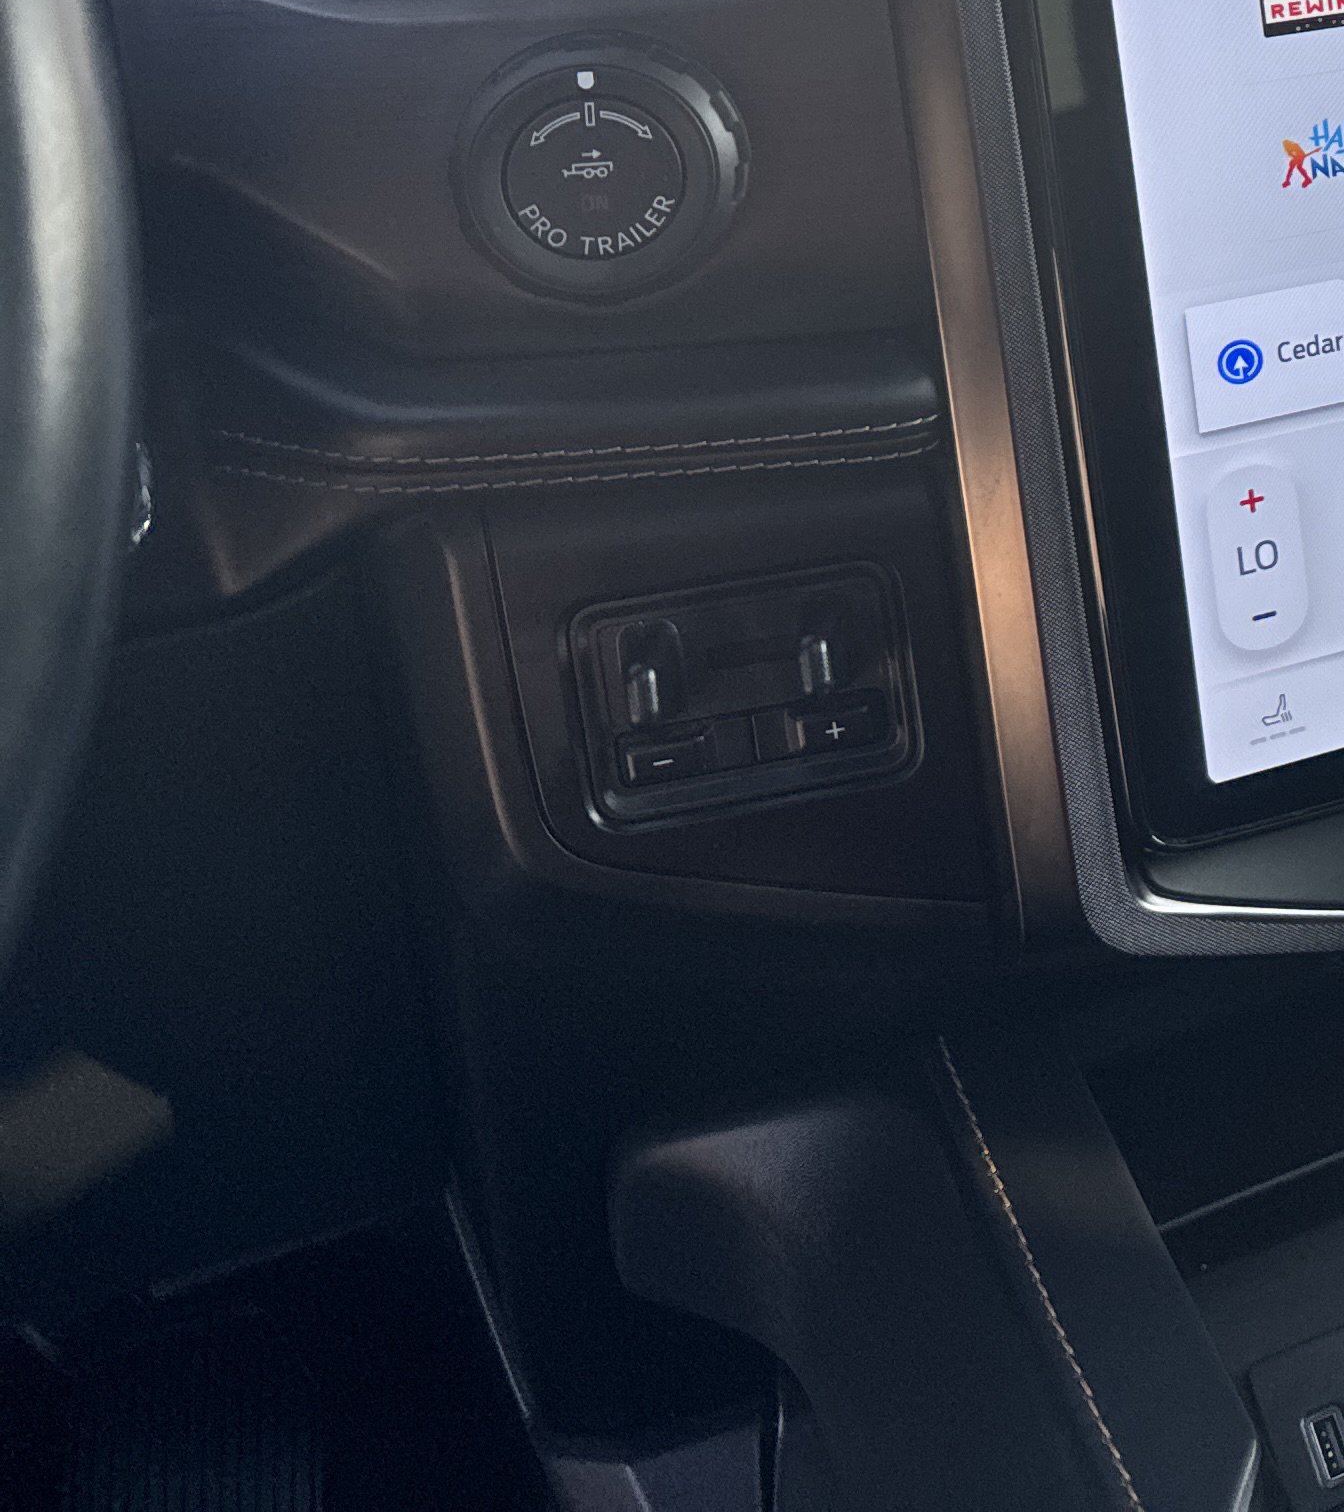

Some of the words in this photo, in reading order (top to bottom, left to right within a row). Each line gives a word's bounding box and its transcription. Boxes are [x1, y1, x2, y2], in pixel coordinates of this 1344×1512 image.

[517, 203, 568, 248] PRO
[579, 194, 676, 256] TRAILER
[1277, 331, 1343, 364] Cedar
[1236, 539, 1279, 576] LO
